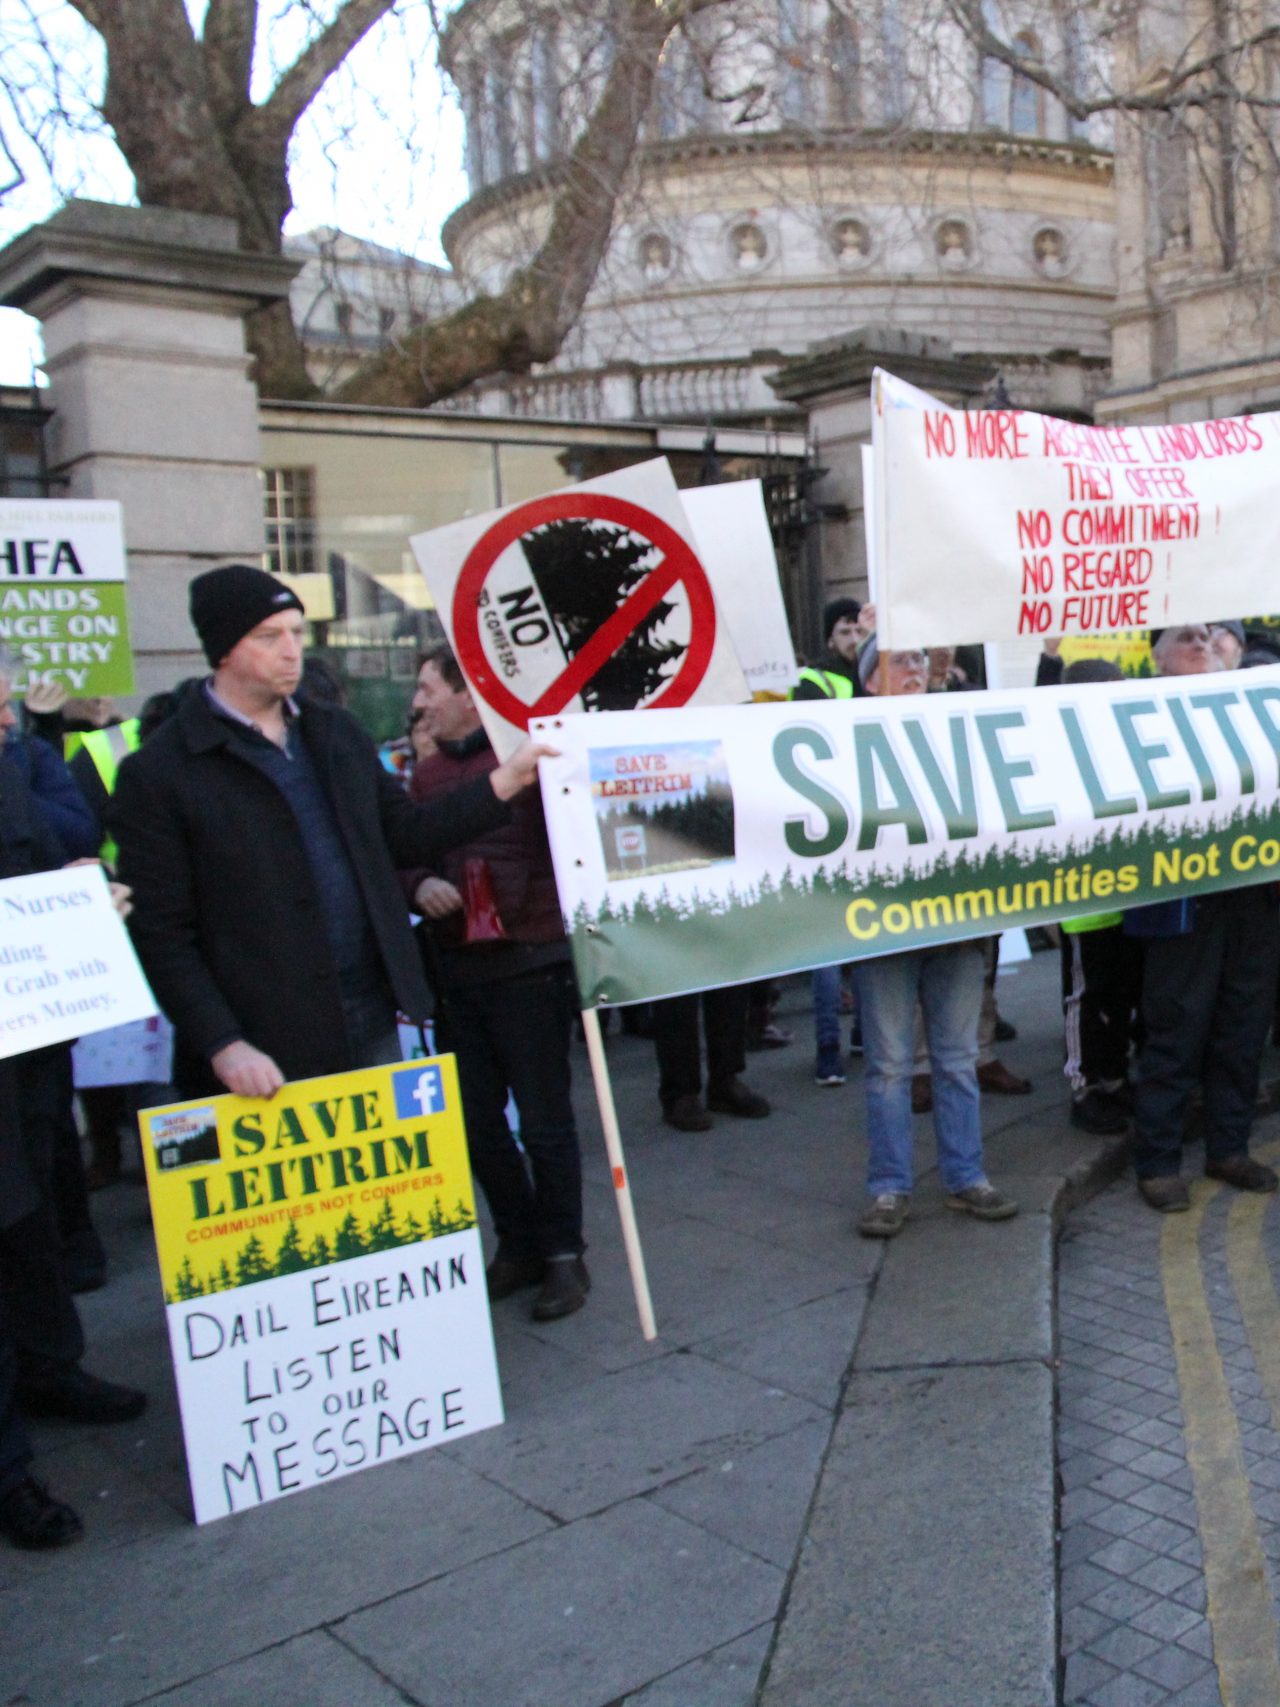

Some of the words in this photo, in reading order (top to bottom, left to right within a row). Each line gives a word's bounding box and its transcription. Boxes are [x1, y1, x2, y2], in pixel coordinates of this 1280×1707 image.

[924, 410, 956, 459] NO
[964, 409, 1030, 459] MORE
[1139, 415, 1264, 463] LANDLORDS
[1062, 462, 1114, 501] THEY
[1125, 467, 1195, 498] OFFER
[1017, 509, 1052, 549] NO
[1062, 502, 1200, 546] COMMITMENT
[1021, 554, 1054, 595] NO
[1062, 547, 1154, 593] REGARD
[67, 614, 119, 638] ON
[497, 585, 550, 647] NO
[1018, 599, 1052, 635] NO
[1060, 590, 1150, 631] FUTURE
[599, 773, 693, 797] LEITRIM
[615, 755, 669, 774] SAVE
[771, 708, 1058, 858] SAVE
[4, 887, 94, 919] Nurses
[845, 864, 1140, 940] Communities
[1152, 842, 1220, 888] Not
[4, 970, 60, 997] Grab
[64, 958, 109, 981] with
[41, 992, 118, 1019] Money.
[231, 1090, 384, 1158] SAVE
[188, 1130, 434, 1221] LEITRIM
[185, 1203, 315, 1245] COMMUNITIES
[320, 1191, 356, 1213] NOT
[359, 1172, 445, 1203] CONIFERS
[241, 1411, 288, 1444] TO
[323, 1378, 390, 1416] OUR
[221, 1387, 466, 1513] MESSAGE
